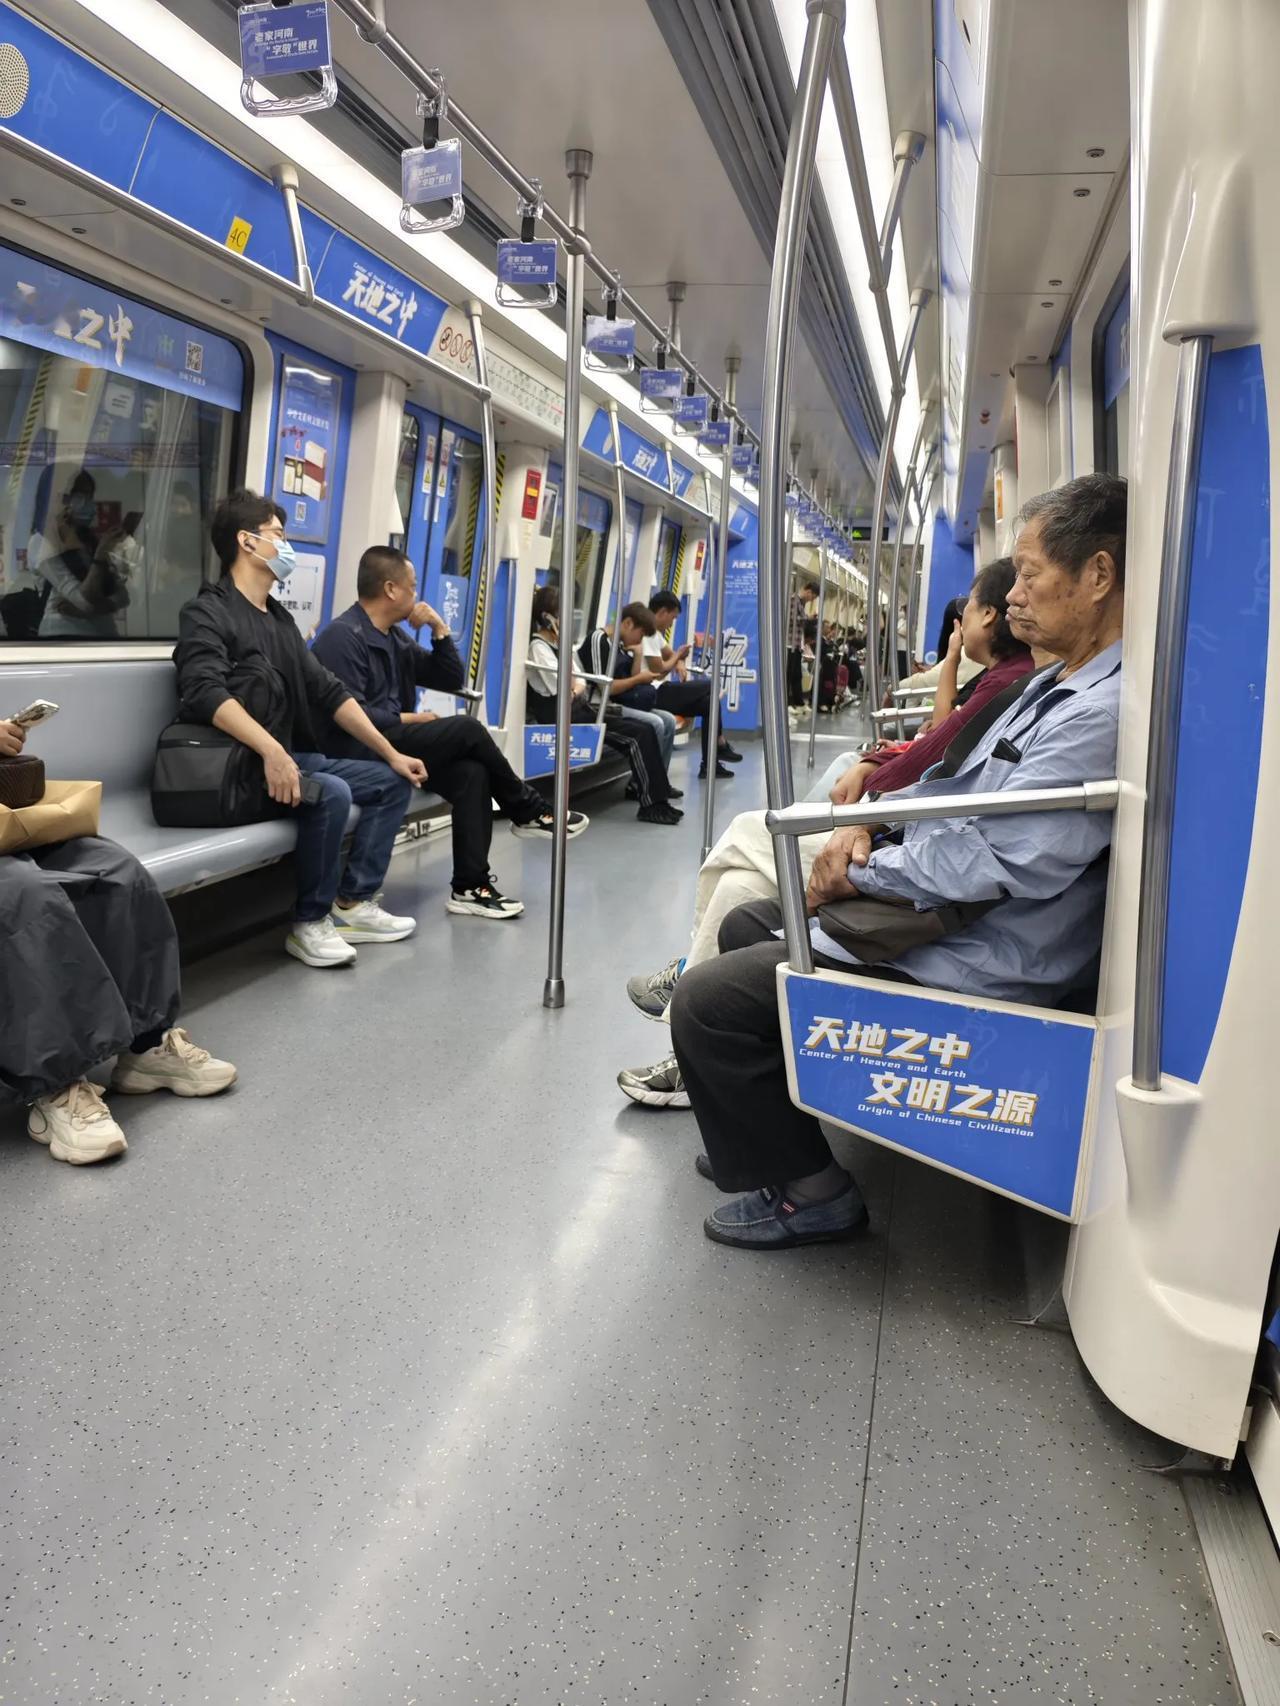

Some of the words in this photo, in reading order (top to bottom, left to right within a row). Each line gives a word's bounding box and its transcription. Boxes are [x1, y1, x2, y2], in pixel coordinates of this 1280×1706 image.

[342, 270, 418, 340] 天地之中
[799, 1048, 837, 1060] Center
[860, 1056, 901, 1070] Heaven
[907, 1063, 928, 1073] and
[934, 1067, 967, 1079] Earth
[803, 1015, 971, 1067] 天地之中
[858, 1104, 893, 1117] Origin
[899, 1110, 910, 1119] of
[916, 1112, 962, 1127] Chinese
[968, 1120, 1034, 1138] Civilization
[864, 1070, 1038, 1126] 文明之源
